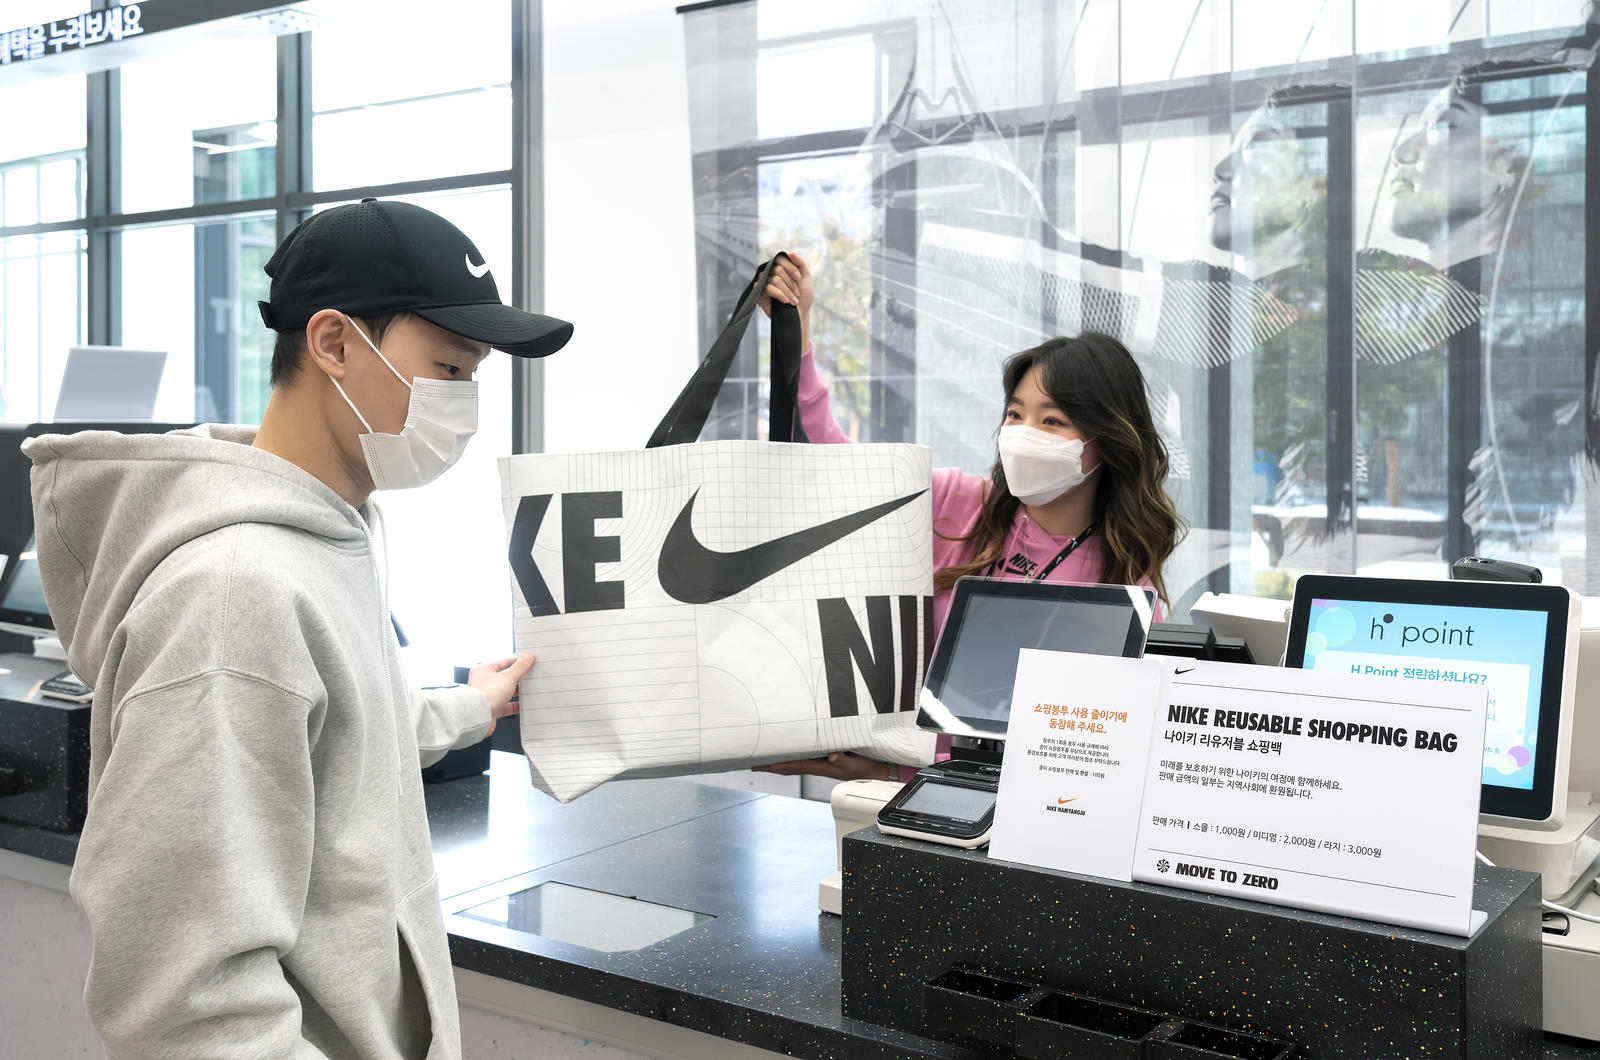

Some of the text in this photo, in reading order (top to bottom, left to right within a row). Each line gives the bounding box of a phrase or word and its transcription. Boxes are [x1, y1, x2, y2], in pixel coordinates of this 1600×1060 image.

[48, 4, 144, 54] 누려보세요
[1009, 553, 1038, 574] NIKE
[1401, 621, 1475, 647] point
[1033, 703, 1127, 723] 쇼핑봉투 사용 줄이기에
[1049, 718, 1107, 734] 동참해 주세요.
[1164, 730, 1282, 755] 나이키 리유저블 쇼핑백
[1167, 705, 1458, 753] NIKE REUSABLE SHOPPING BAG
[1159, 771, 1313, 799] 판매 금액의 일부는 지역사회에 환원됩니다.
[1160, 760, 1342, 790] 미래를 보호하기 위한 나이키의 여정에 함께하세요.
[1152, 815, 1168, 826] 판매
[1168, 818, 1184, 829] 가격
[1192, 822, 1209, 833] 스몰
[1215, 825, 1246, 838] 1,000원
[1253, 830, 1277, 843] 미디엄
[1283, 835, 1316, 849] 2,000원
[1323, 840, 1341, 852] 라지
[1347, 844, 1382, 858] 3,000원
[1175, 862, 1279, 891] MOVE TO ZERO
